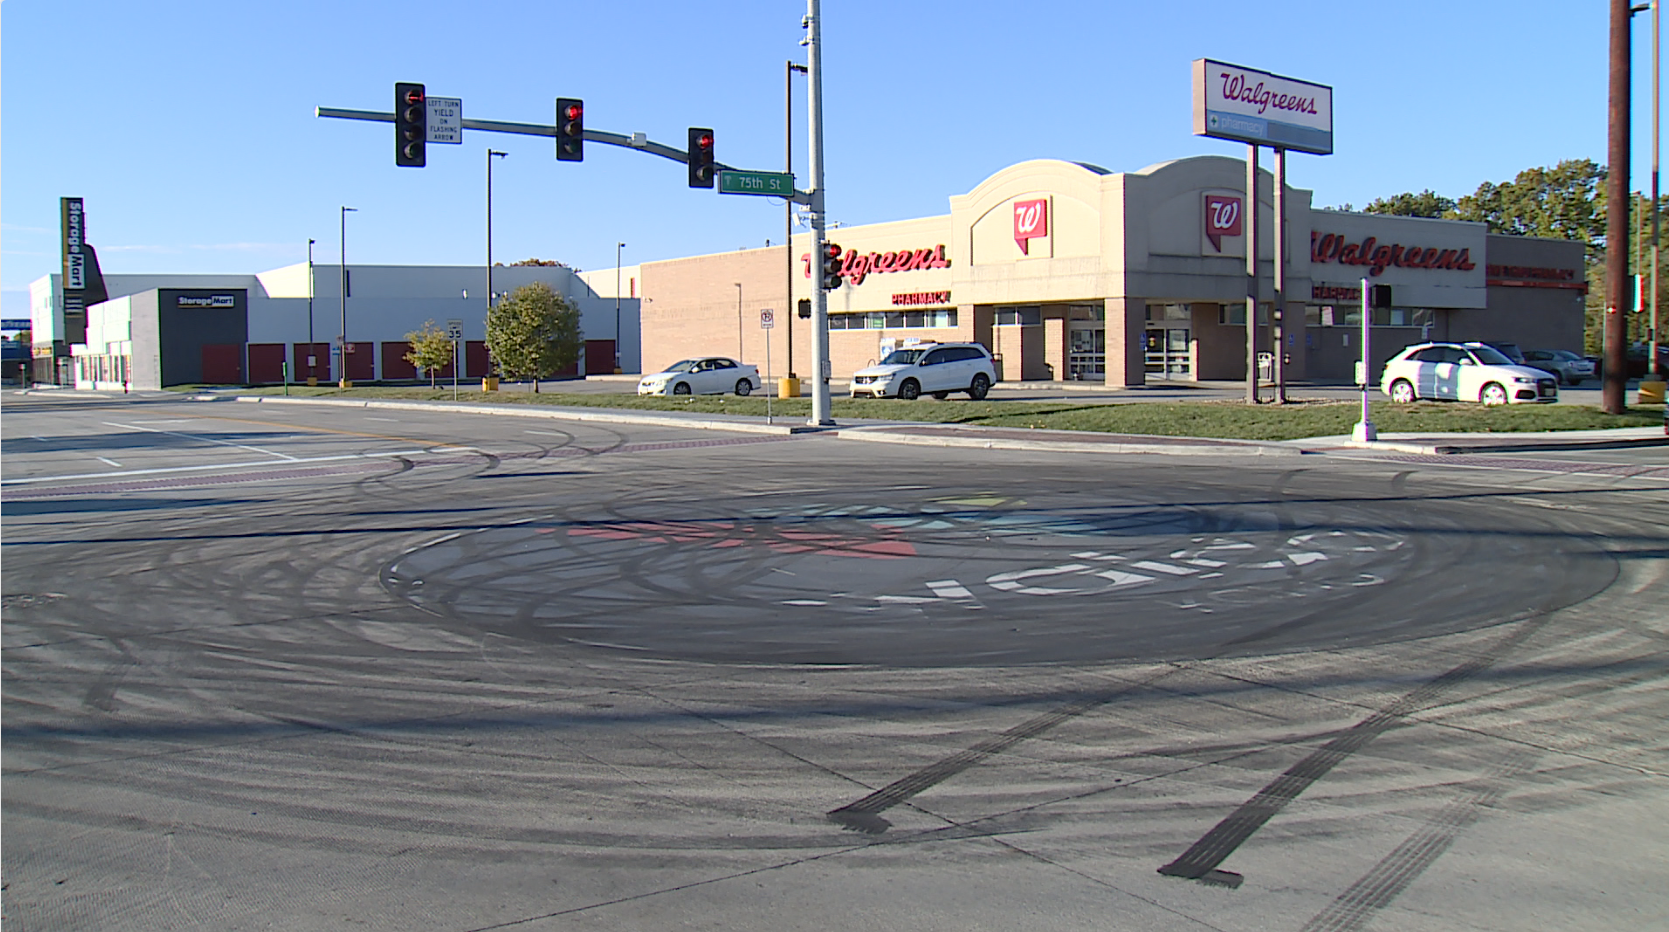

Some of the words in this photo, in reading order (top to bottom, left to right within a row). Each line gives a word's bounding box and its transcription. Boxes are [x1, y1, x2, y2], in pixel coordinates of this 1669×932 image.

[1220, 73, 1317, 114] Walgreens
[434, 108, 454, 117] YIELD
[430, 125, 457, 133] FLASHING
[1221, 117, 1265, 136] pharmacy
[739, 176, 763, 189] 75th
[770, 178, 781, 190] St
[892, 290, 950, 305] PHARMACY
[449, 330, 462, 338] 35
